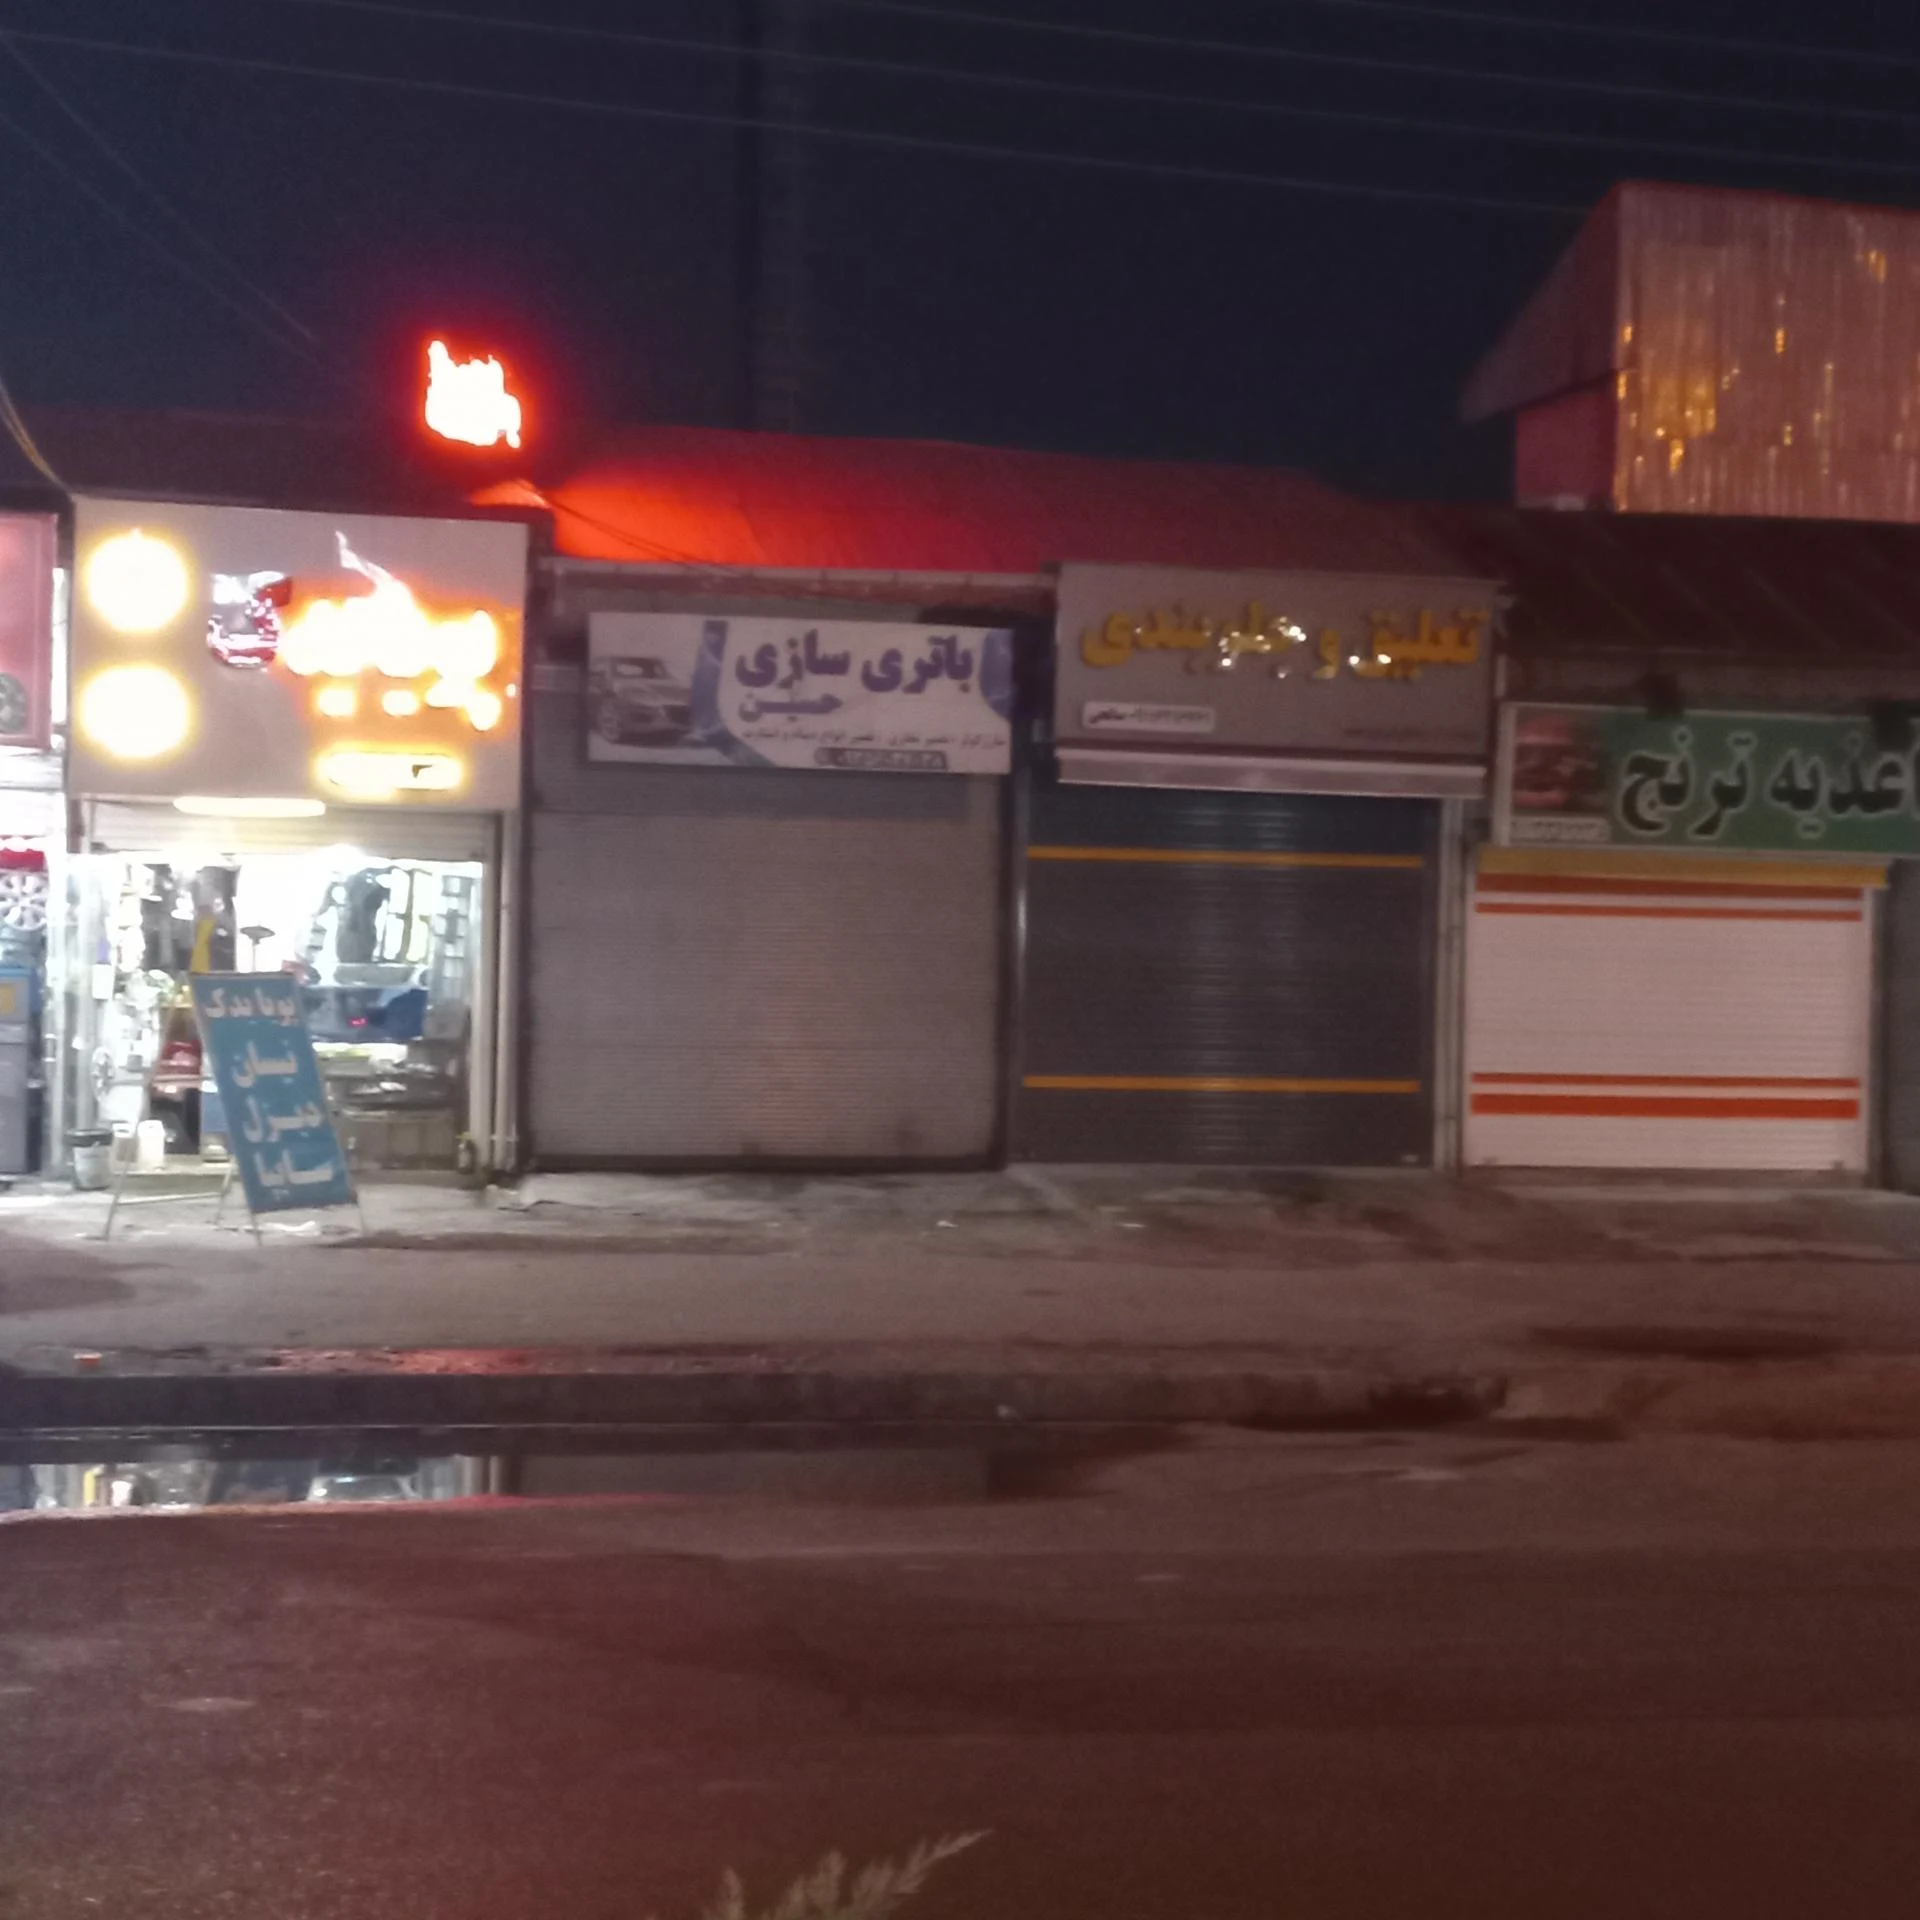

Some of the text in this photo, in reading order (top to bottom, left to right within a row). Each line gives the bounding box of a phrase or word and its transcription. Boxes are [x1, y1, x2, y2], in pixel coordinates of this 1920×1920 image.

[735, 629, 973, 694] باتری سازی
[1314, 629, 1340, 679] و
[1619, 725, 1757, 840] ترنج
[232, 1039, 298, 1088] نیسان
[253, 1148, 335, 1199] سایپا
